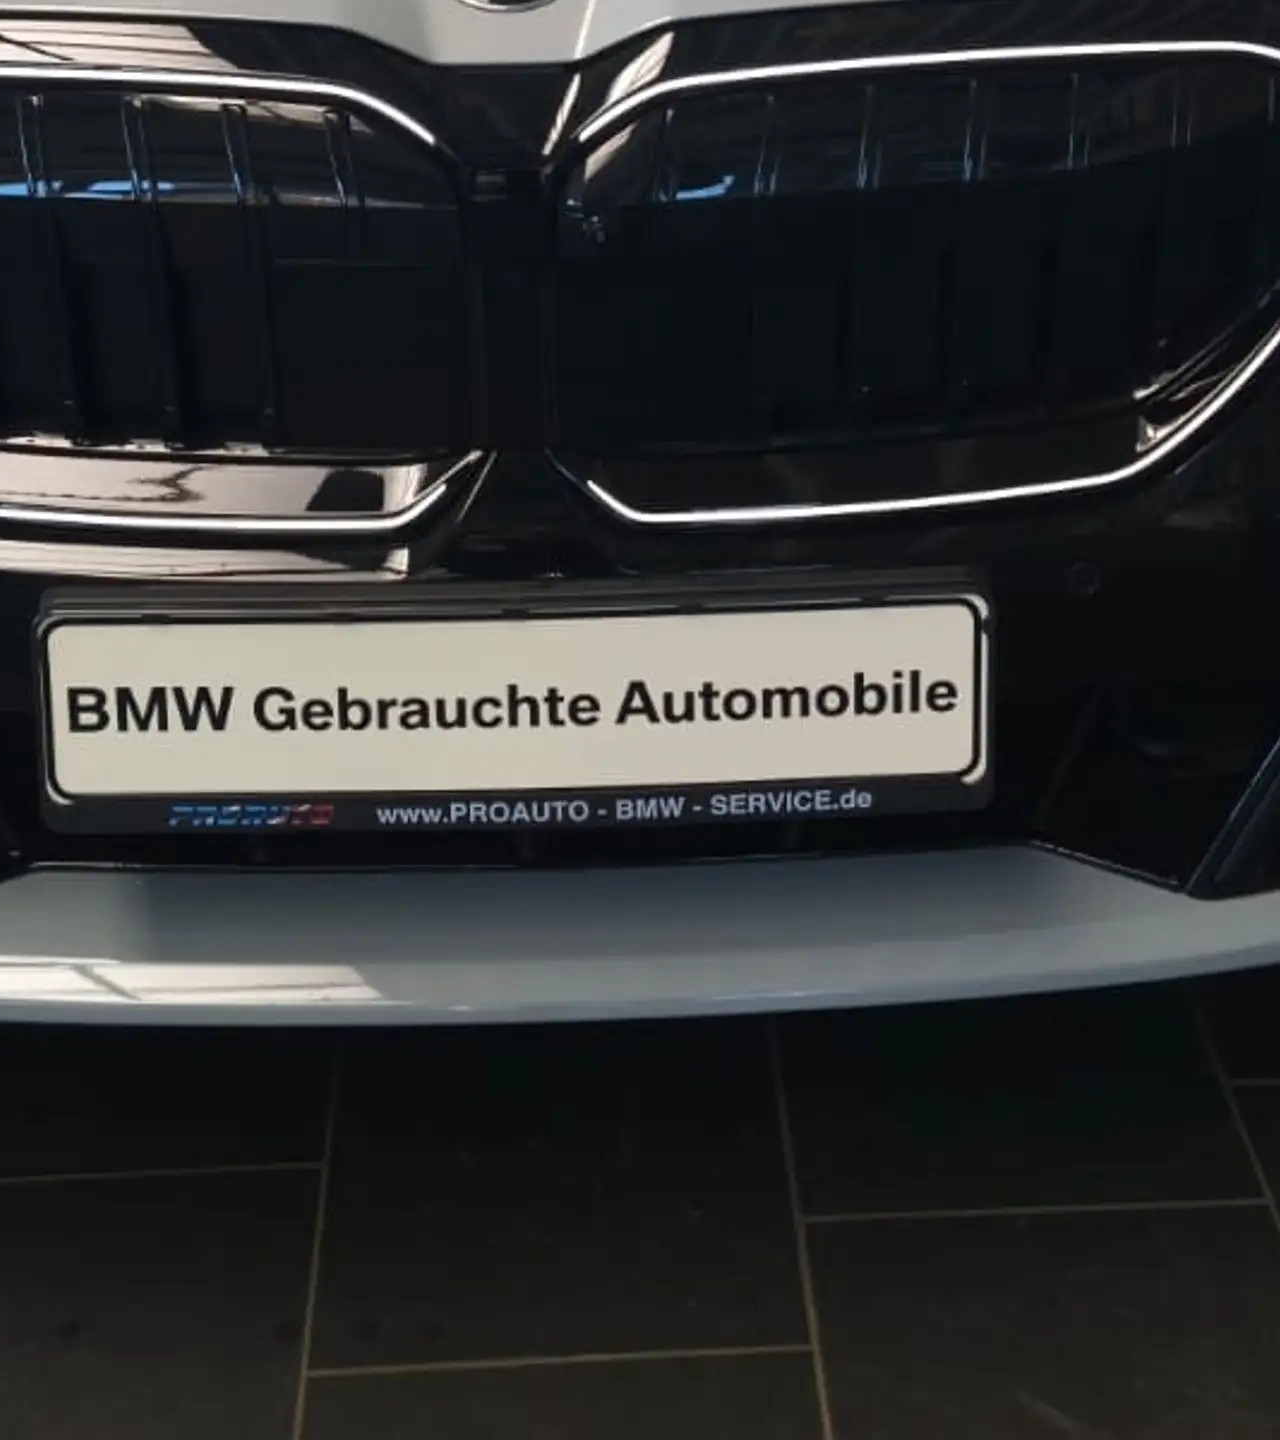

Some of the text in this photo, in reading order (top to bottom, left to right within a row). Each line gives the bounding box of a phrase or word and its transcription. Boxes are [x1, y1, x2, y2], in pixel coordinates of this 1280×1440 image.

[67, 669, 958, 733] BMW Gebrauchte Automobile
[376, 800, 589, 824] www.PROAUTO
[615, 796, 685, 820] BMW
[710, 789, 872, 815] SERVICE.de
